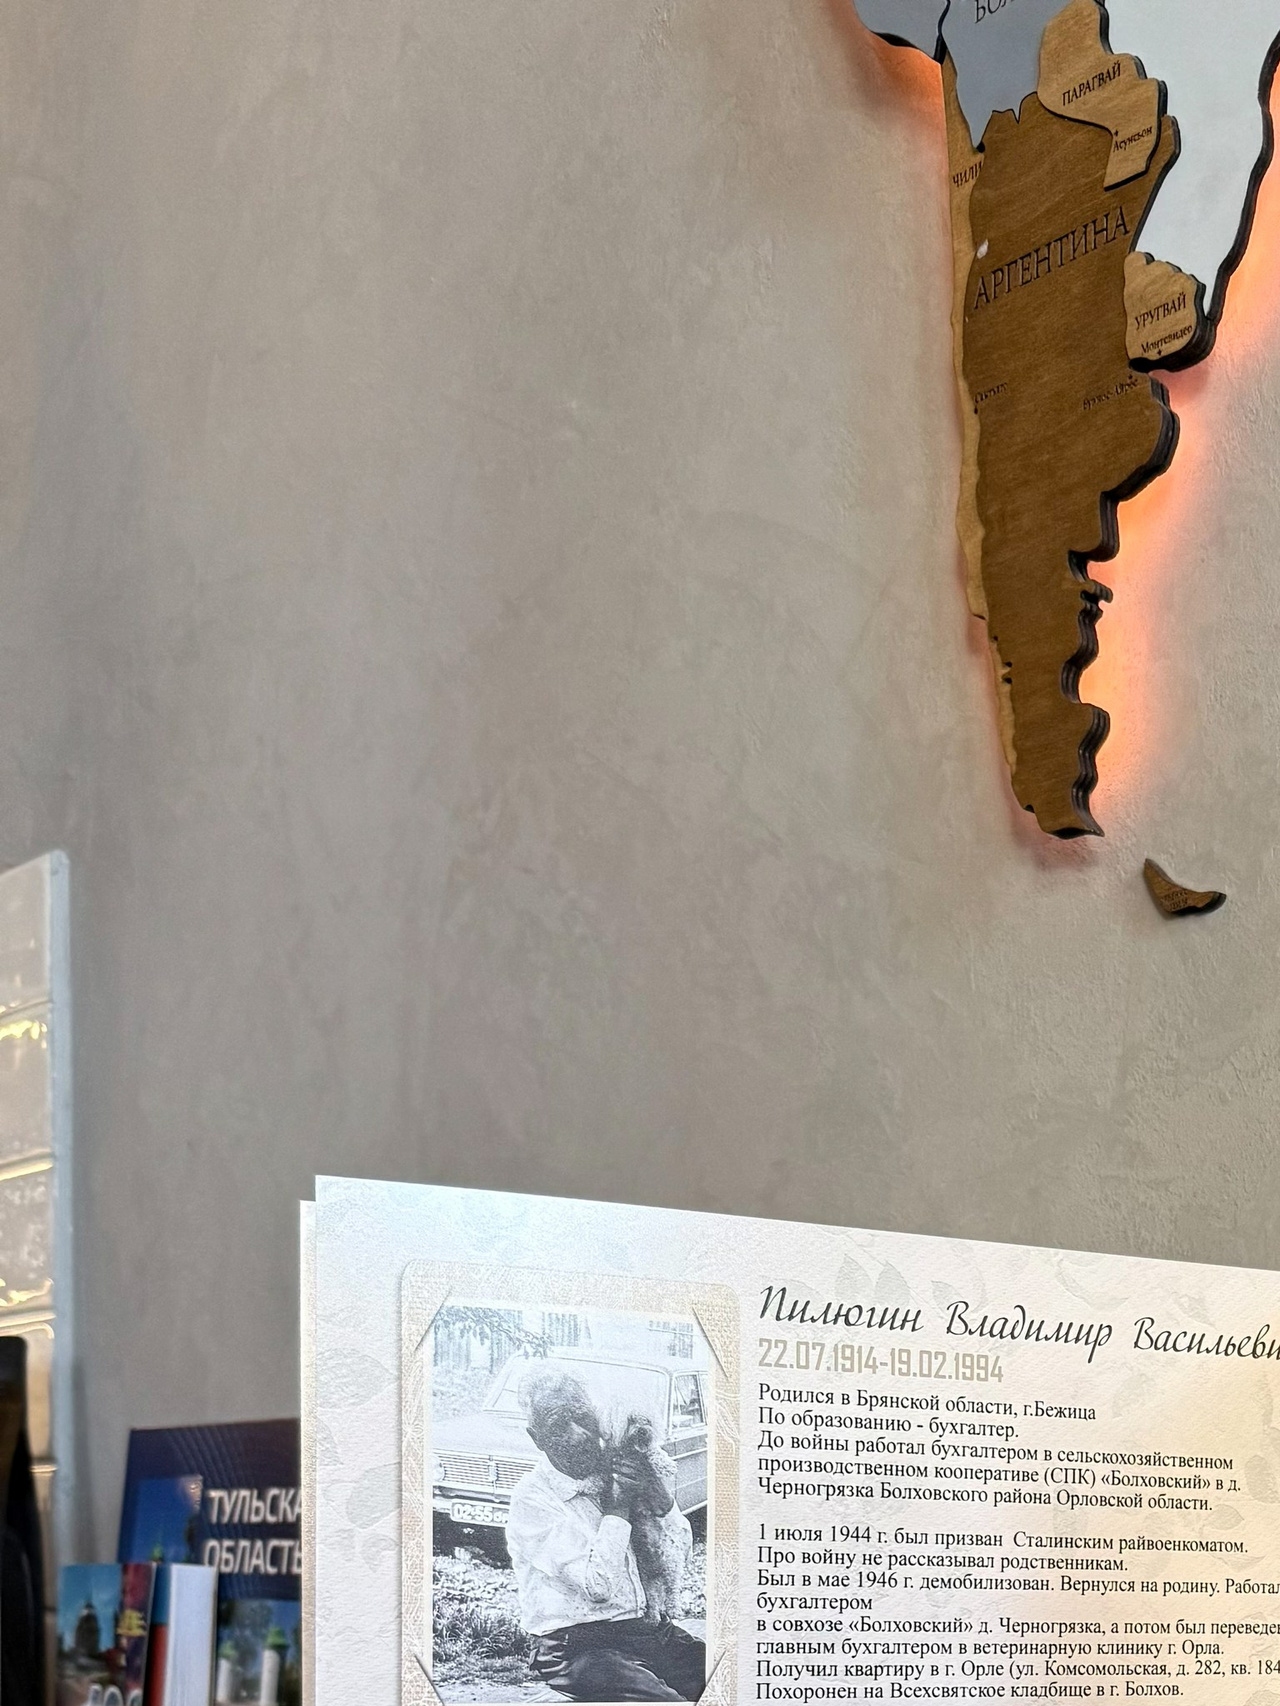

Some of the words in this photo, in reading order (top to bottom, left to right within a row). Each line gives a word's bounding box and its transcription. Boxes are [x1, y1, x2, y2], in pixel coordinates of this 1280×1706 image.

[1062, 60, 1122, 106] ПАРАГВАЙ
[973, 205, 1131, 310] АРГЕНТИНА
[1134, 291, 1186, 331] УРУГВАЙ
[759, 1284, 924, 1333] Пилюгин
[946, 1300, 1113, 1363] Владимир
[758, 1337, 1004, 1383] 22.07.1914-19.02.1994
[758, 1382, 834, 1405] Родился
[841, 1393, 850, 1405] в
[857, 1389, 940, 1412] Брянской
[945, 1396, 1018, 1419] области,
[1023, 1400, 1096, 1420] г.Бежица
[758, 1407, 785, 1425] По
[791, 1410, 912, 1433] образованию
[929, 1416, 1019, 1441] бухгалтер.
[758, 1430, 784, 1451] До
[791, 1432, 849, 1452] войны
[854, 1436, 925, 1457] работал
[932, 1439, 1038, 1464] бухгалтером
[1044, 1449, 1052, 1462] в
[1057, 1448, 1233, 1470] сельскохозяйственном
[758, 1456, 928, 1479] производственном
[934, 1464, 1039, 1485] кооперативе
[1044, 1467, 1097, 1488] (СПК)
[1101, 1469, 1211, 1490] «Болховский»
[1215, 1479, 1224, 1490] в
[1228, 1478, 1241, 1493] д.
[758, 1476, 874, 1499] Черногрязка
[880, 1481, 988, 1503] Болховского
[993, 1486, 1051, 1507] района
[1056, 1489, 1143, 1510] Орловской
[1147, 1493, 1213, 1511] области.
[758, 1523, 766, 1540] 1
[774, 1527, 823, 1542] июля
[830, 1525, 872, 1543] 1944
[877, 1531, 888, 1544] г.
[894, 1527, 929, 1545] был
[935, 1532, 1003, 1549] призван
[1013, 1531, 1113, 1550] Сталинским
[1118, 1535, 1248, 1554] райвоенкоматом.
[758, 1546, 795, 1568] Про
[801, 1548, 856, 1569] войну
[862, 1552, 883, 1567] не
[888, 1553, 995, 1570] рассказывал
[1000, 1554, 1128, 1572] родственникам.
[757, 1569, 795, 1587] Был
[802, 1575, 811, 1587] в
[817, 1574, 850, 1587] мае
[856, 1571, 898, 1588] 1946
[903, 1576, 914, 1589] г.
[920, 1573, 1054, 1591] демобилизован.
[1060, 1575, 1135, 1595] Вернулся
[1140, 1580, 1158, 1593] на
[1162, 1579, 1220, 1597] родину.
[756, 1592, 873, 1614] бухгалтером
[756, 1619, 766, 1632] в
[772, 1618, 843, 1632] совхозе
[849, 1615, 973, 1634] «Болховский»
[978, 1621, 993, 1635] д.
[998, 1616, 1106, 1636] Черногрязка,
[1110, 1623, 1119, 1635] а
[1124, 1622, 1171, 1635] потом
[1175, 1618, 1205, 1635] был
[755, 1640, 835, 1655] главным
[841, 1638, 953, 1659] бухгалтером
[959, 1643, 968, 1655] в
[973, 1641, 1092, 1659] ветеринарную
[1096, 1642, 1163, 1659] клинику
[1168, 1643, 1177, 1655] г.
[1181, 1639, 1224, 1659] Орла.
[755, 1659, 838, 1680] Получил
[844, 1663, 924, 1681] квартиру
[930, 1664, 939, 1677] в
[945, 1664, 956, 1677] г.
[960, 1660, 1004, 1680] Орле
[1009, 1659, 1039, 1680] (ул.
[1045, 1661, 1172, 1677] Комсомольская,
[1176, 1664, 1190, 1678] д.
[1195, 1659, 1226, 1677] 282,
[1230, 1663, 1251, 1676] кв.
[755, 1683, 857, 1703] Похоронен
[864, 1686, 884, 1699] на
[890, 1682, 1005, 1699] Всехсвятское
[1010, 1681, 1092, 1698] кладбище
[1096, 1685, 1105, 1697] в
[1110, 1685, 1120, 1697] г.
[1125, 1681, 1184, 1697] Болхов.
